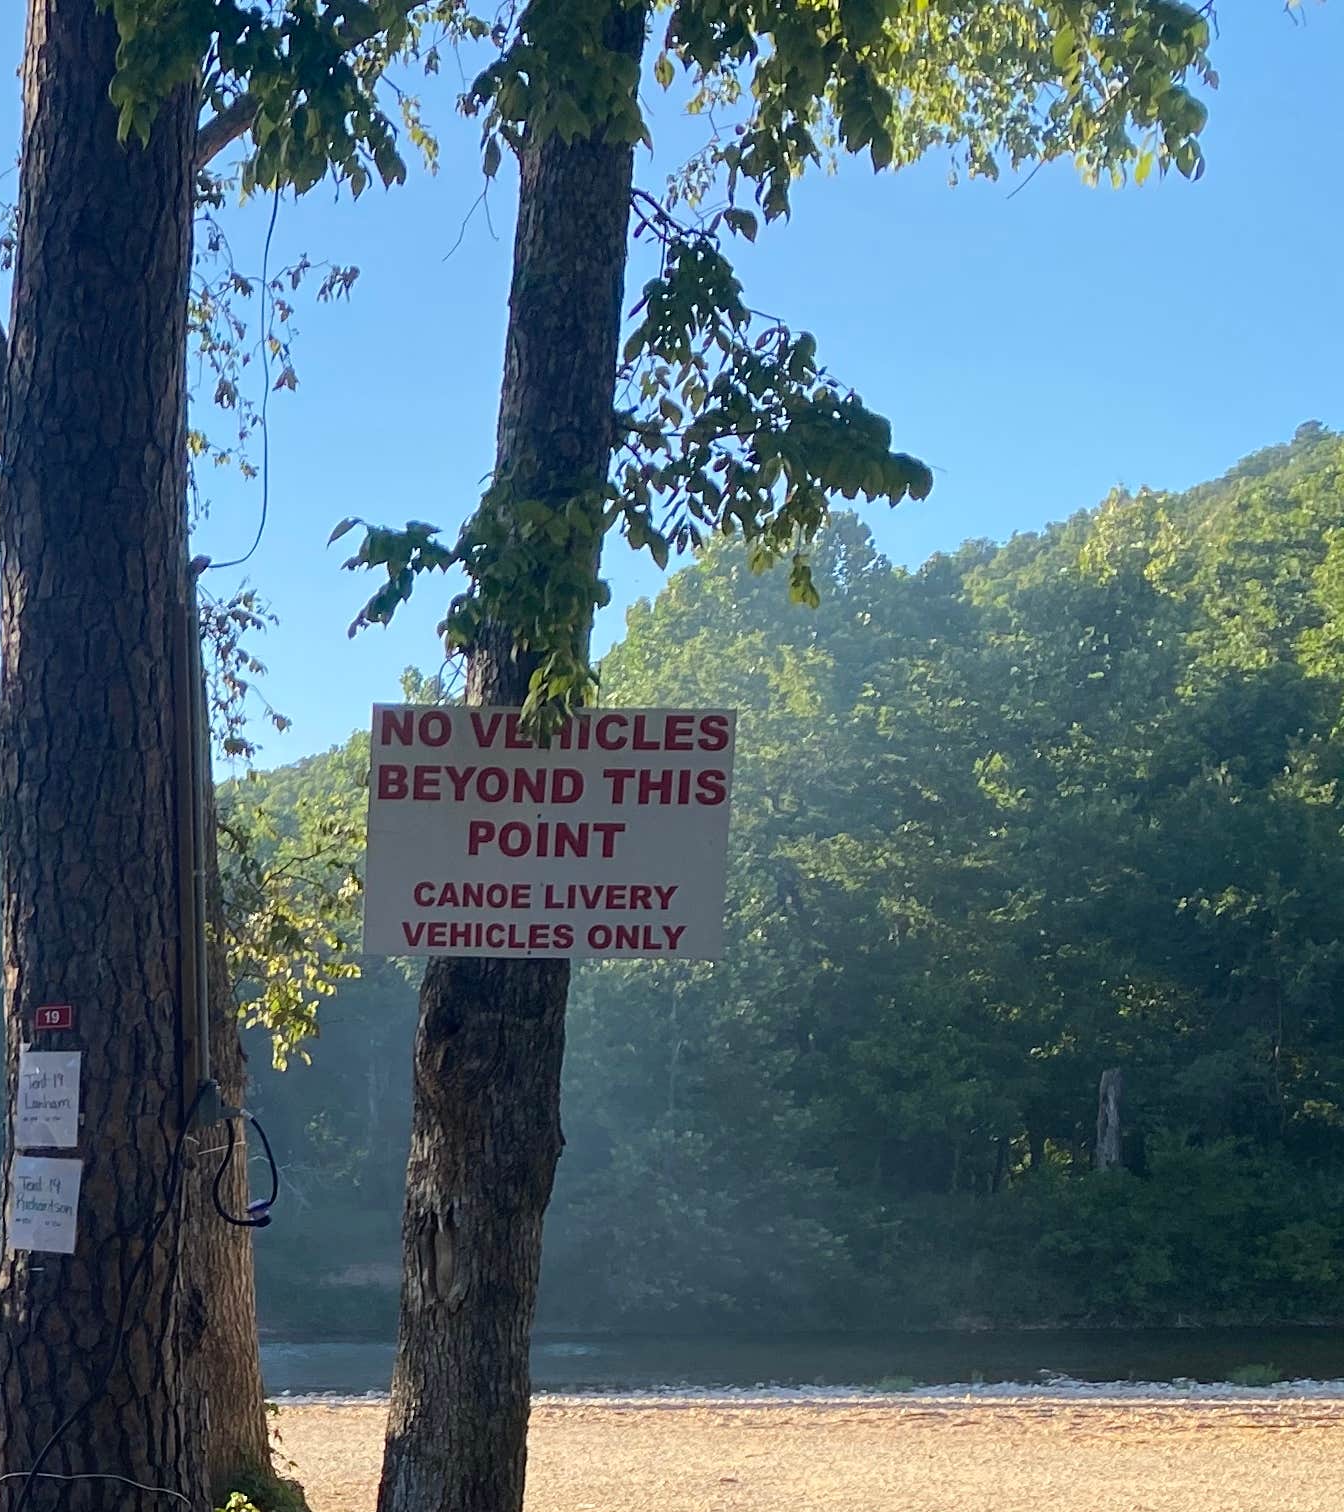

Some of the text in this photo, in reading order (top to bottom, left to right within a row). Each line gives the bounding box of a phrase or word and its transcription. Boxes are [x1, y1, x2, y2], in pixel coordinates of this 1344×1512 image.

[380, 710, 729, 752] NO VEHICLES
[377, 764, 728, 806] BEYOND THIS
[467, 820, 626, 858] POINT
[413, 880, 679, 911] CANOE LIVERY
[402, 920, 687, 951] VEHICLES ONLY
[44, 1010, 60, 1024] 19
